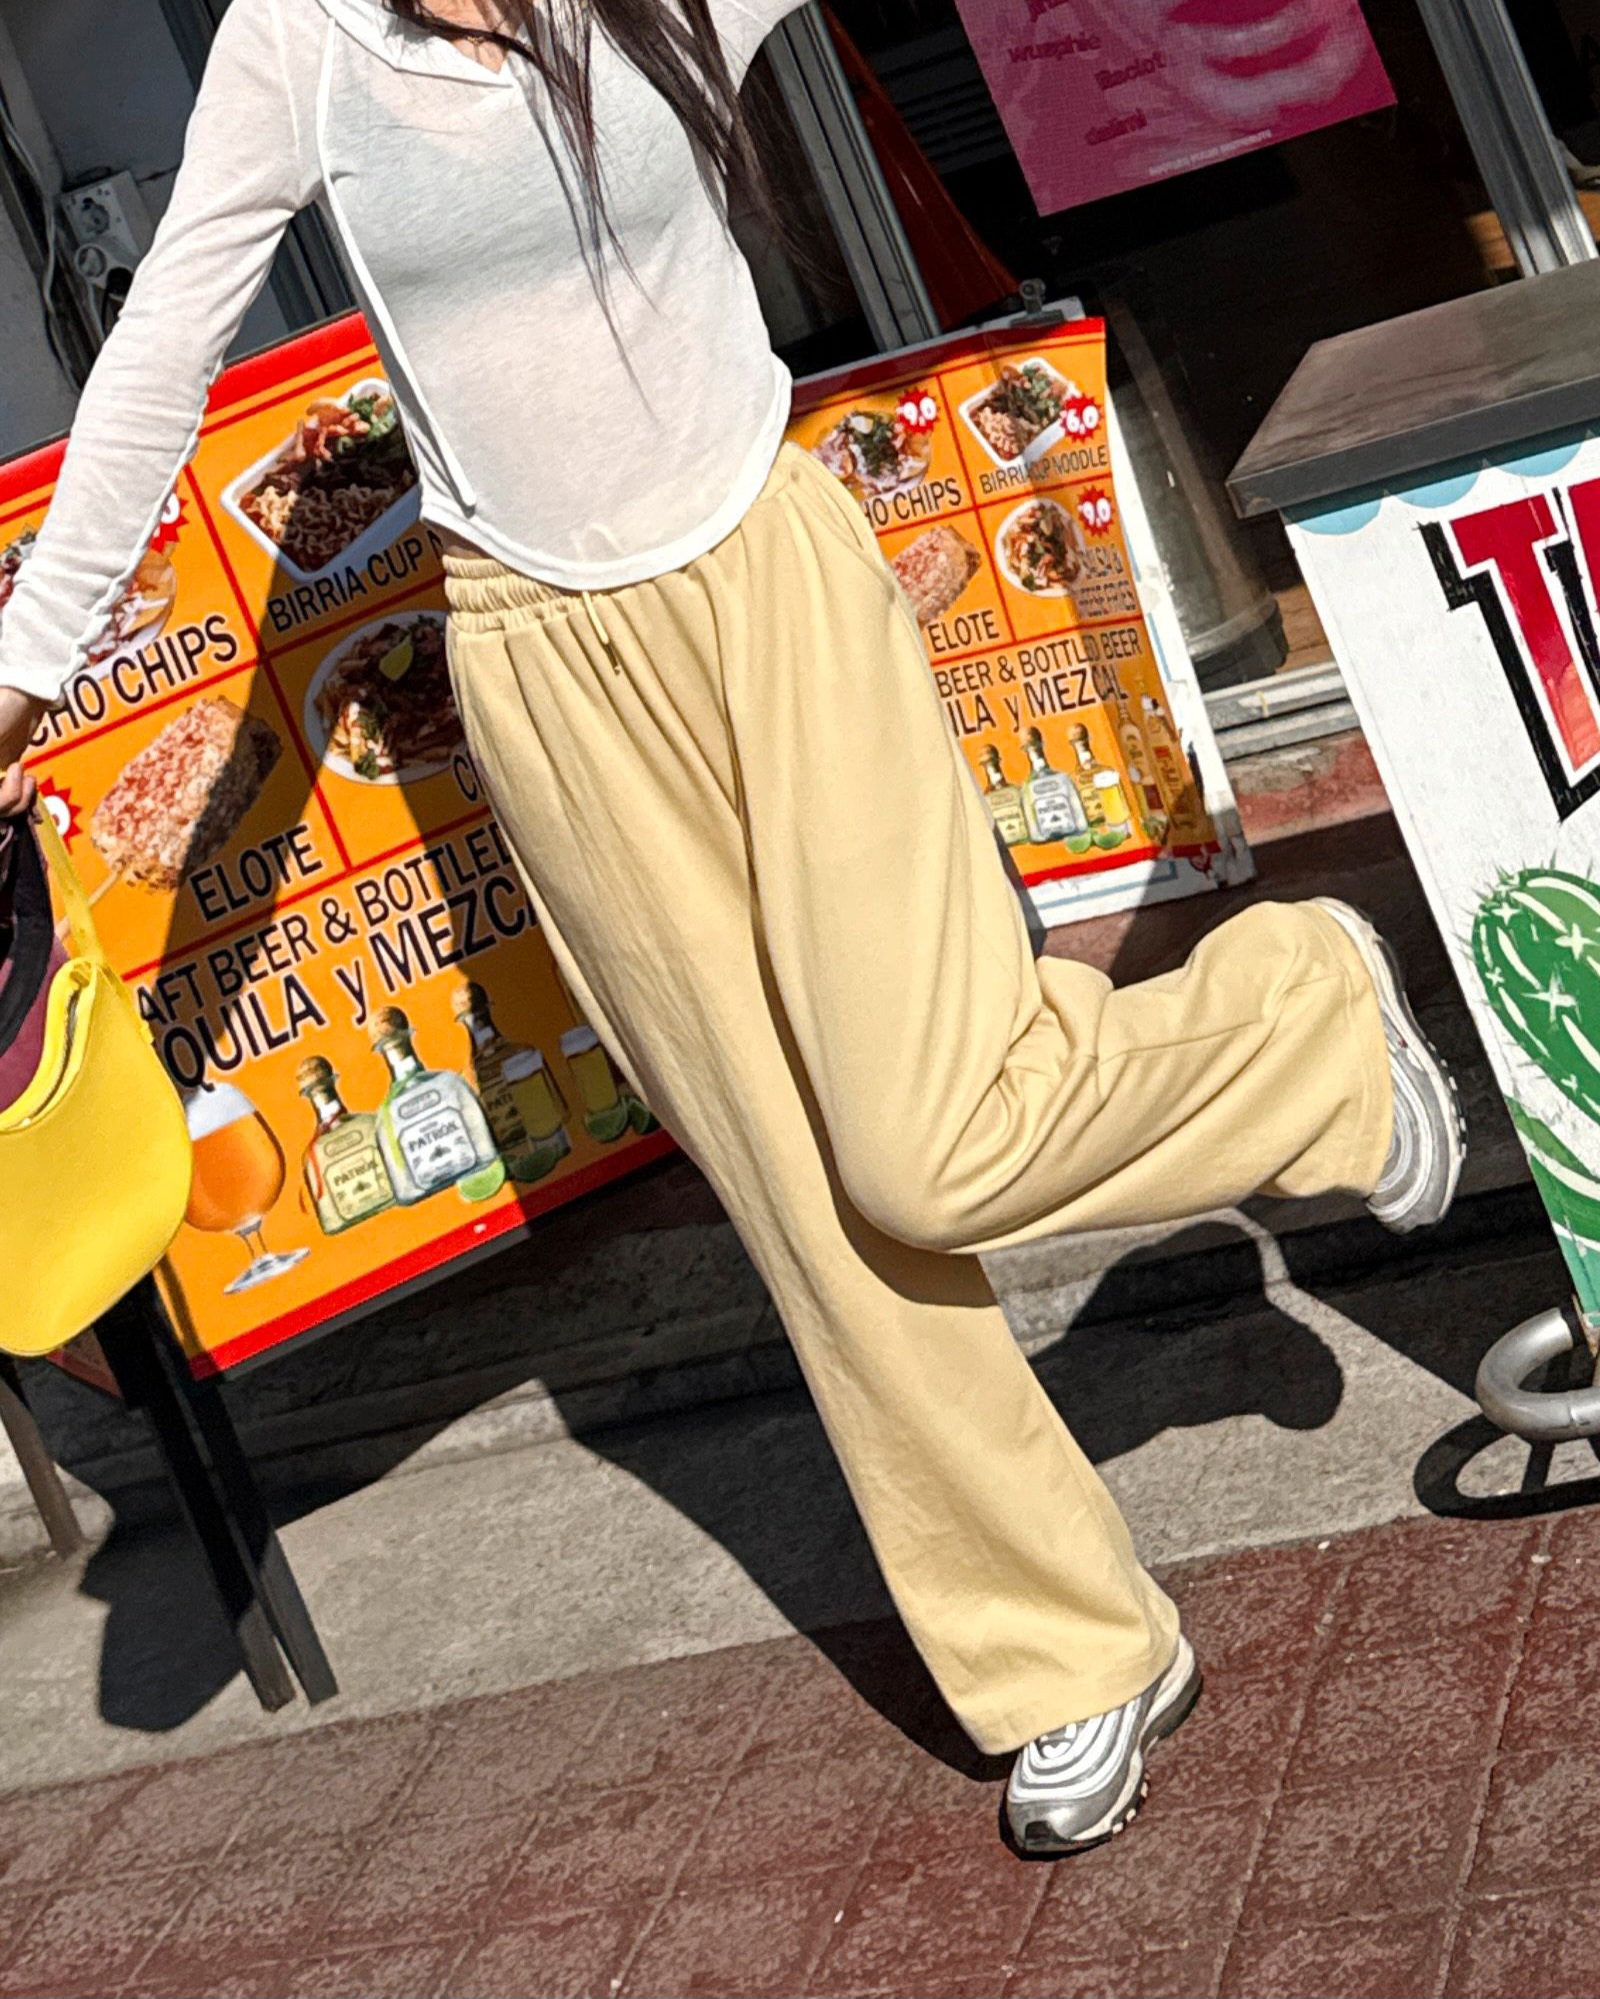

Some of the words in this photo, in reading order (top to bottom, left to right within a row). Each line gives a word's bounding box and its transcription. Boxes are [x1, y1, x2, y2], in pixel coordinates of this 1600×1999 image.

[893, 477, 962, 520] CHIPS
[267, 566, 367, 633] BIRRIA
[367, 537, 423, 587] CUP
[112, 615, 237, 703] CHIPS
[927, 609, 1000, 653] ELOTE
[935, 660, 994, 698] BEER
[997, 655, 1017, 683] &
[1101, 628, 1142, 659] BEER
[1004, 695, 1020, 733] y
[189, 824, 323, 921] ELOTE
[164, 974, 326, 1093] QUILA
[336, 960, 367, 1024] y
[369, 875, 538, 992] MEZC
[208, 914, 318, 997] BEER
[321, 898, 358, 944] &
